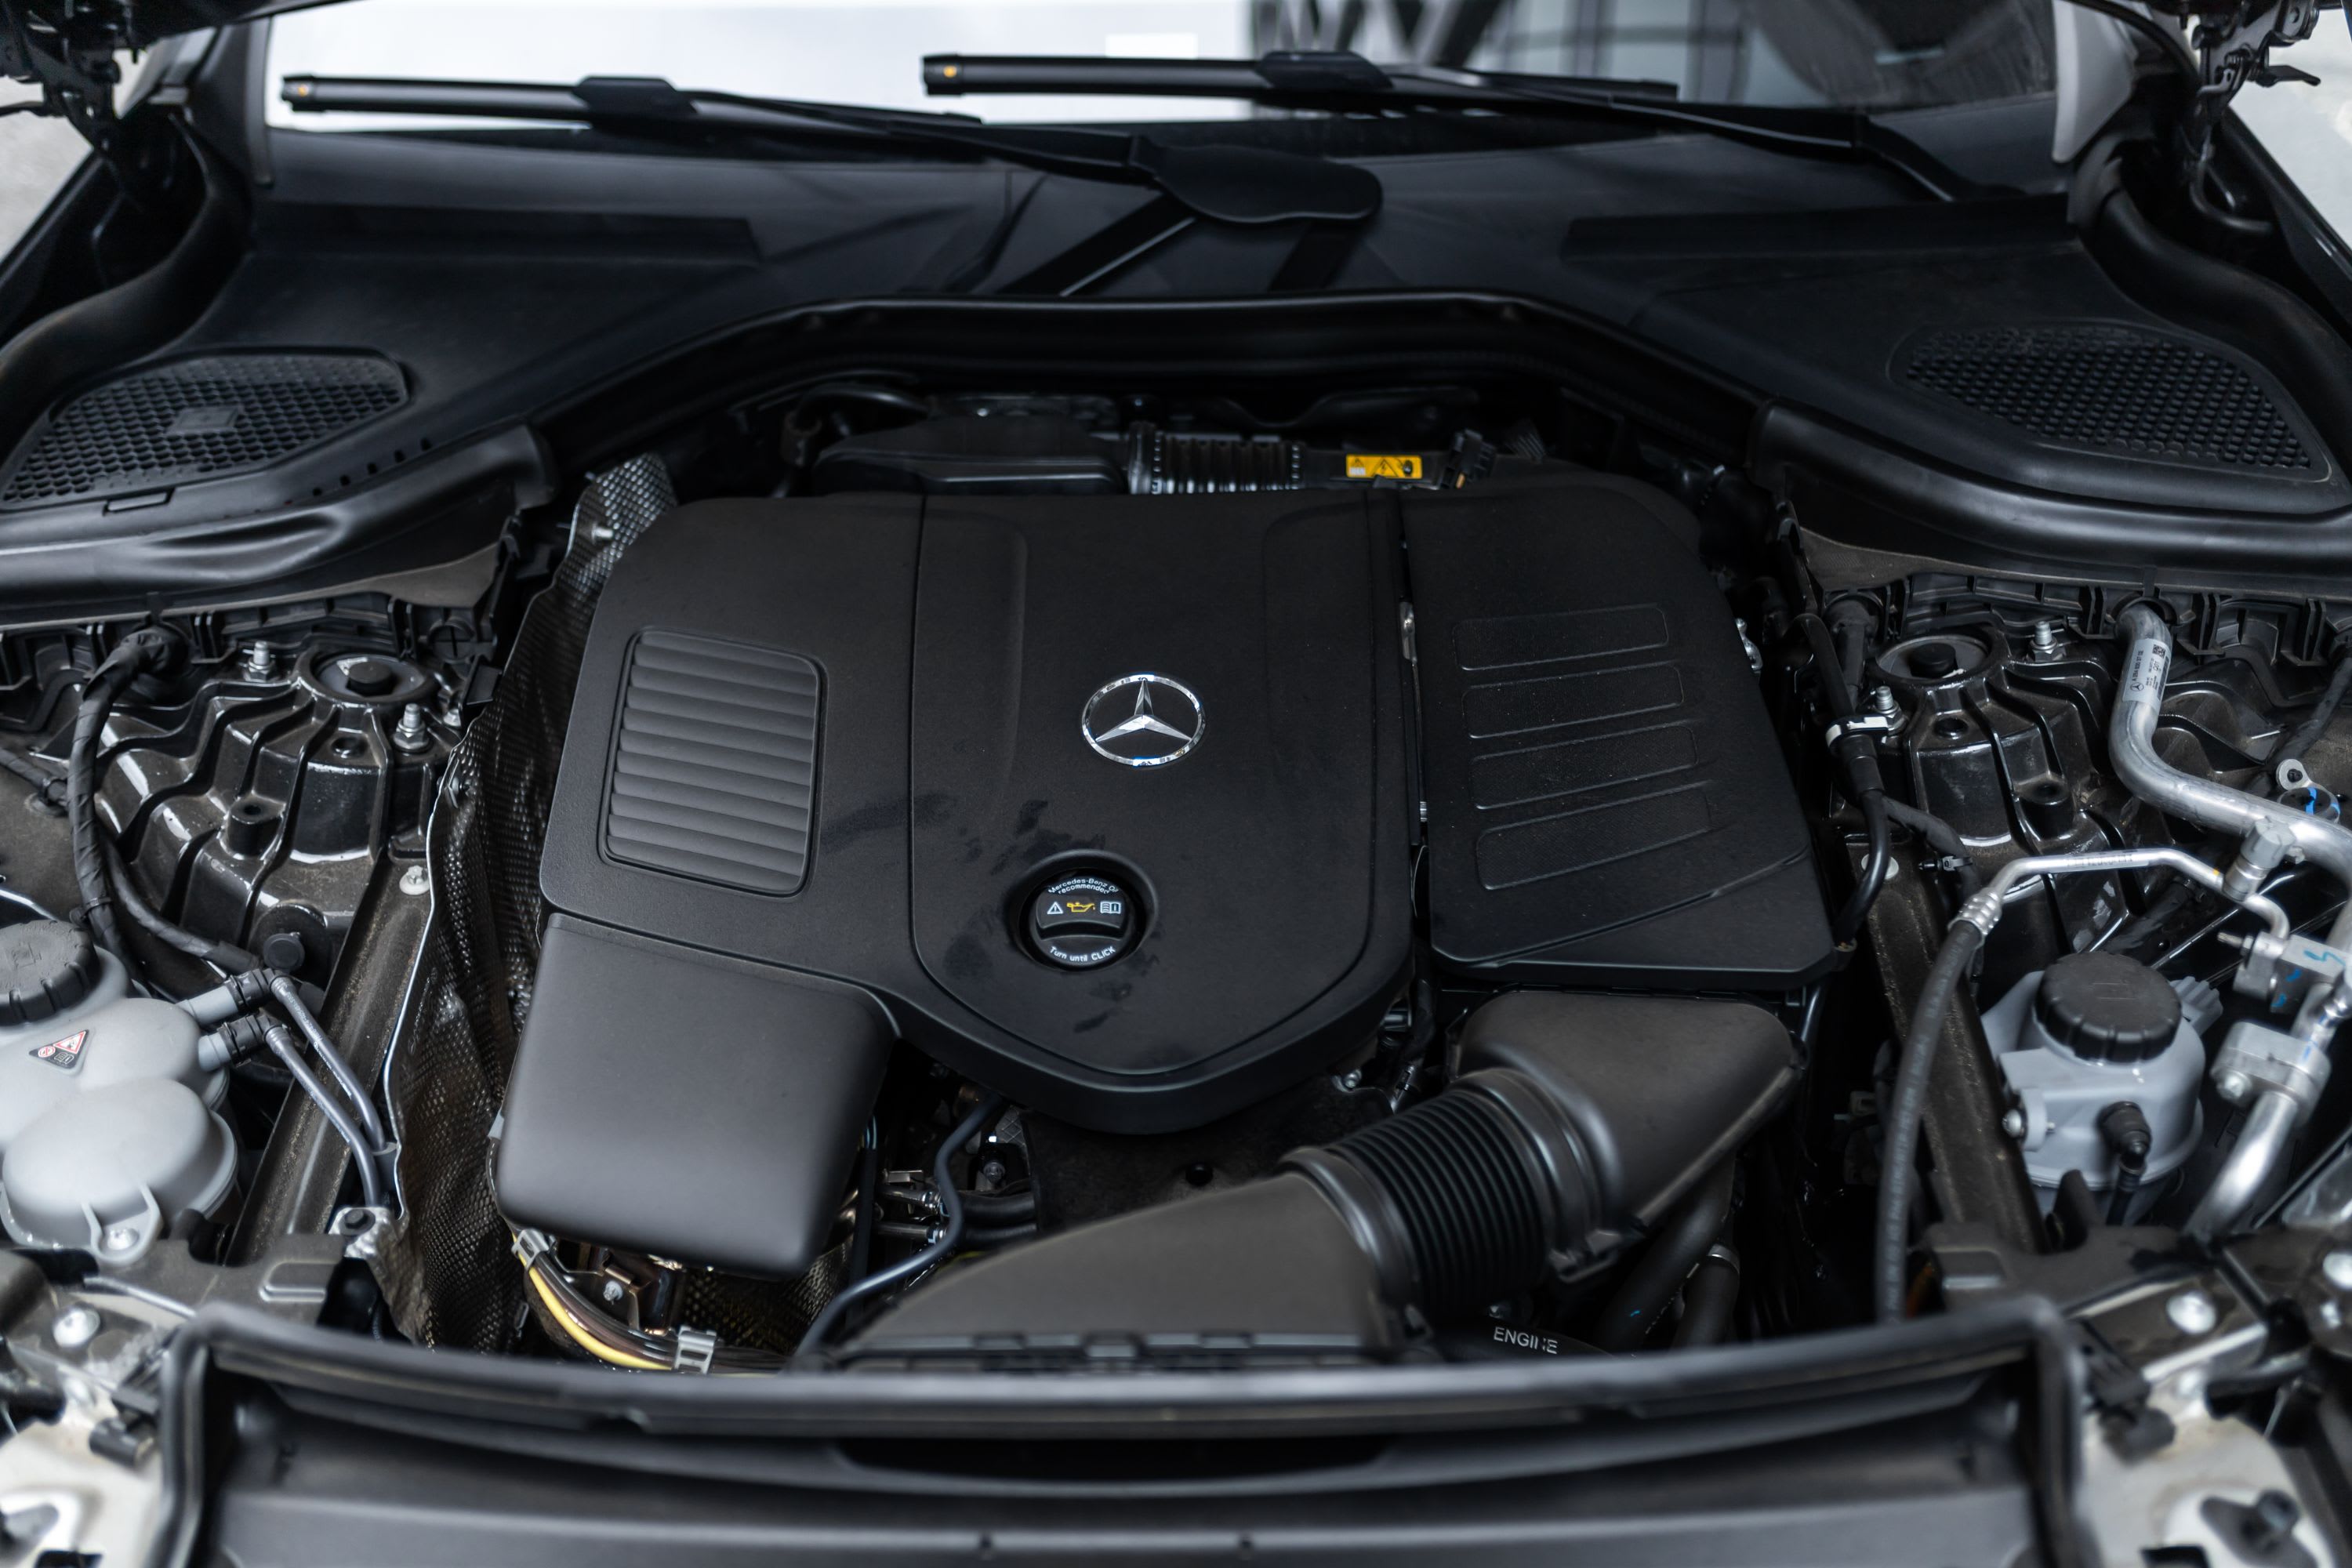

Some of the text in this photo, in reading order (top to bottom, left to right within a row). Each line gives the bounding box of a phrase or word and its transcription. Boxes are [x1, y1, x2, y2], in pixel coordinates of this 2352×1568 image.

[1047, 878, 1108, 893] Mercedes-Benz
[1058, 884, 1110, 895] recommended
[1050, 946, 1067, 960] Turn
[1091, 946, 1116, 960] CLICK
